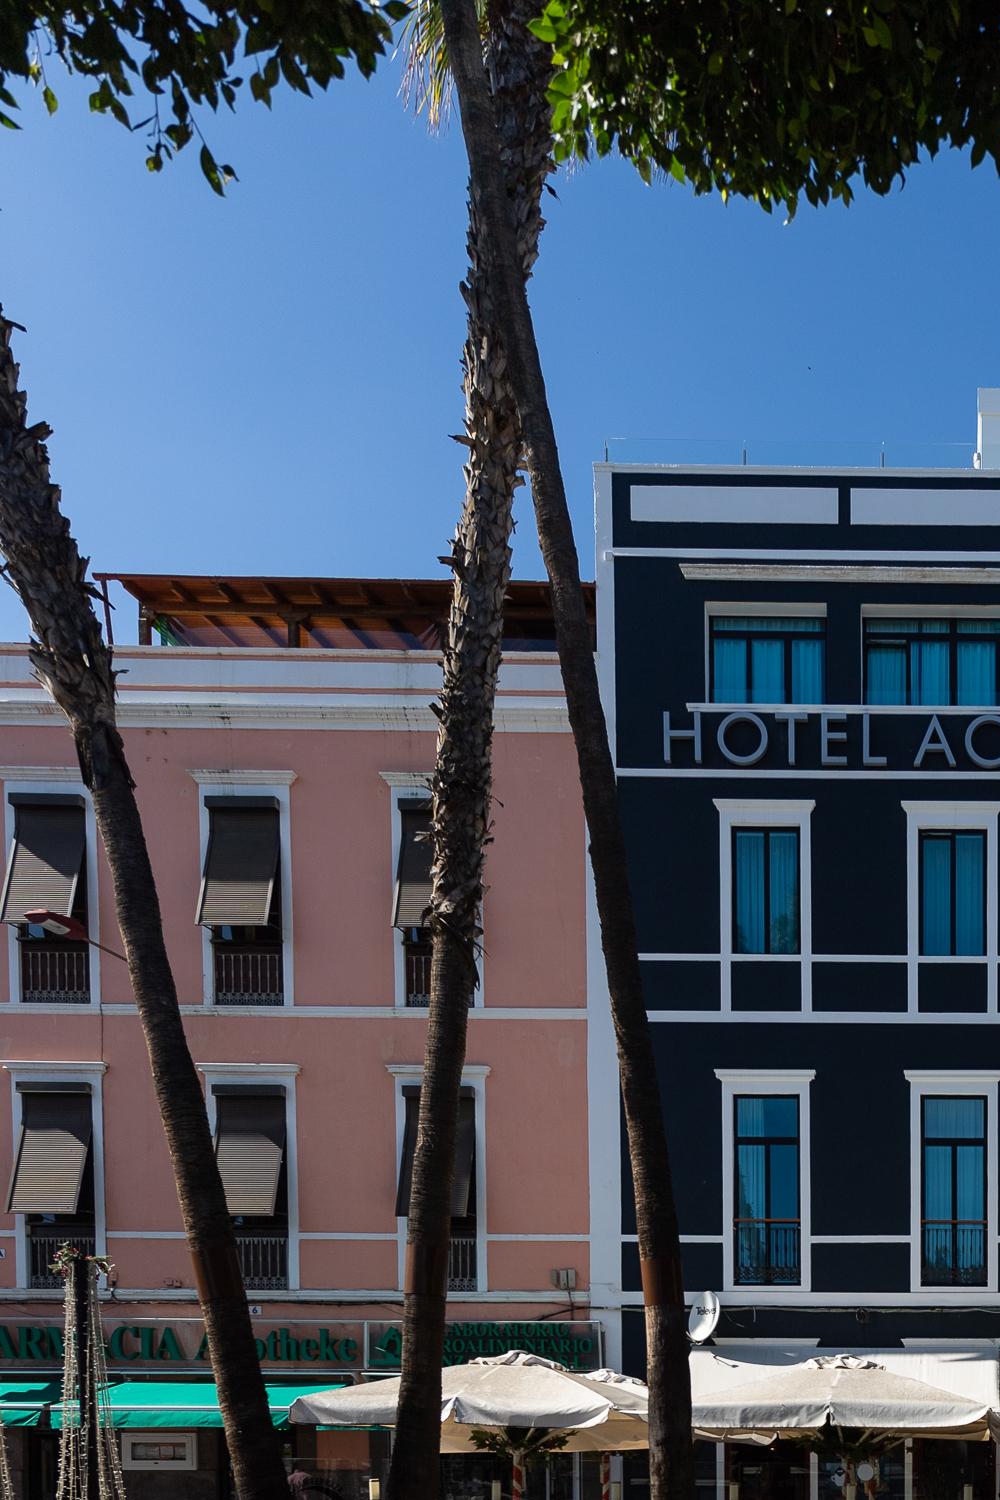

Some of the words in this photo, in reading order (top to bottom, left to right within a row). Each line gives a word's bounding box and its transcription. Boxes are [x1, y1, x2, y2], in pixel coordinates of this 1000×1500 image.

[662, 711, 888, 767] HOTEL
[252, 1306, 258, 1314] 6
[446, 1322, 570, 1338] ABORATORIO
[0, 1326, 187, 1361] ARMCIA
[442, 1338, 593, 1353] ROALIMENTARIO
